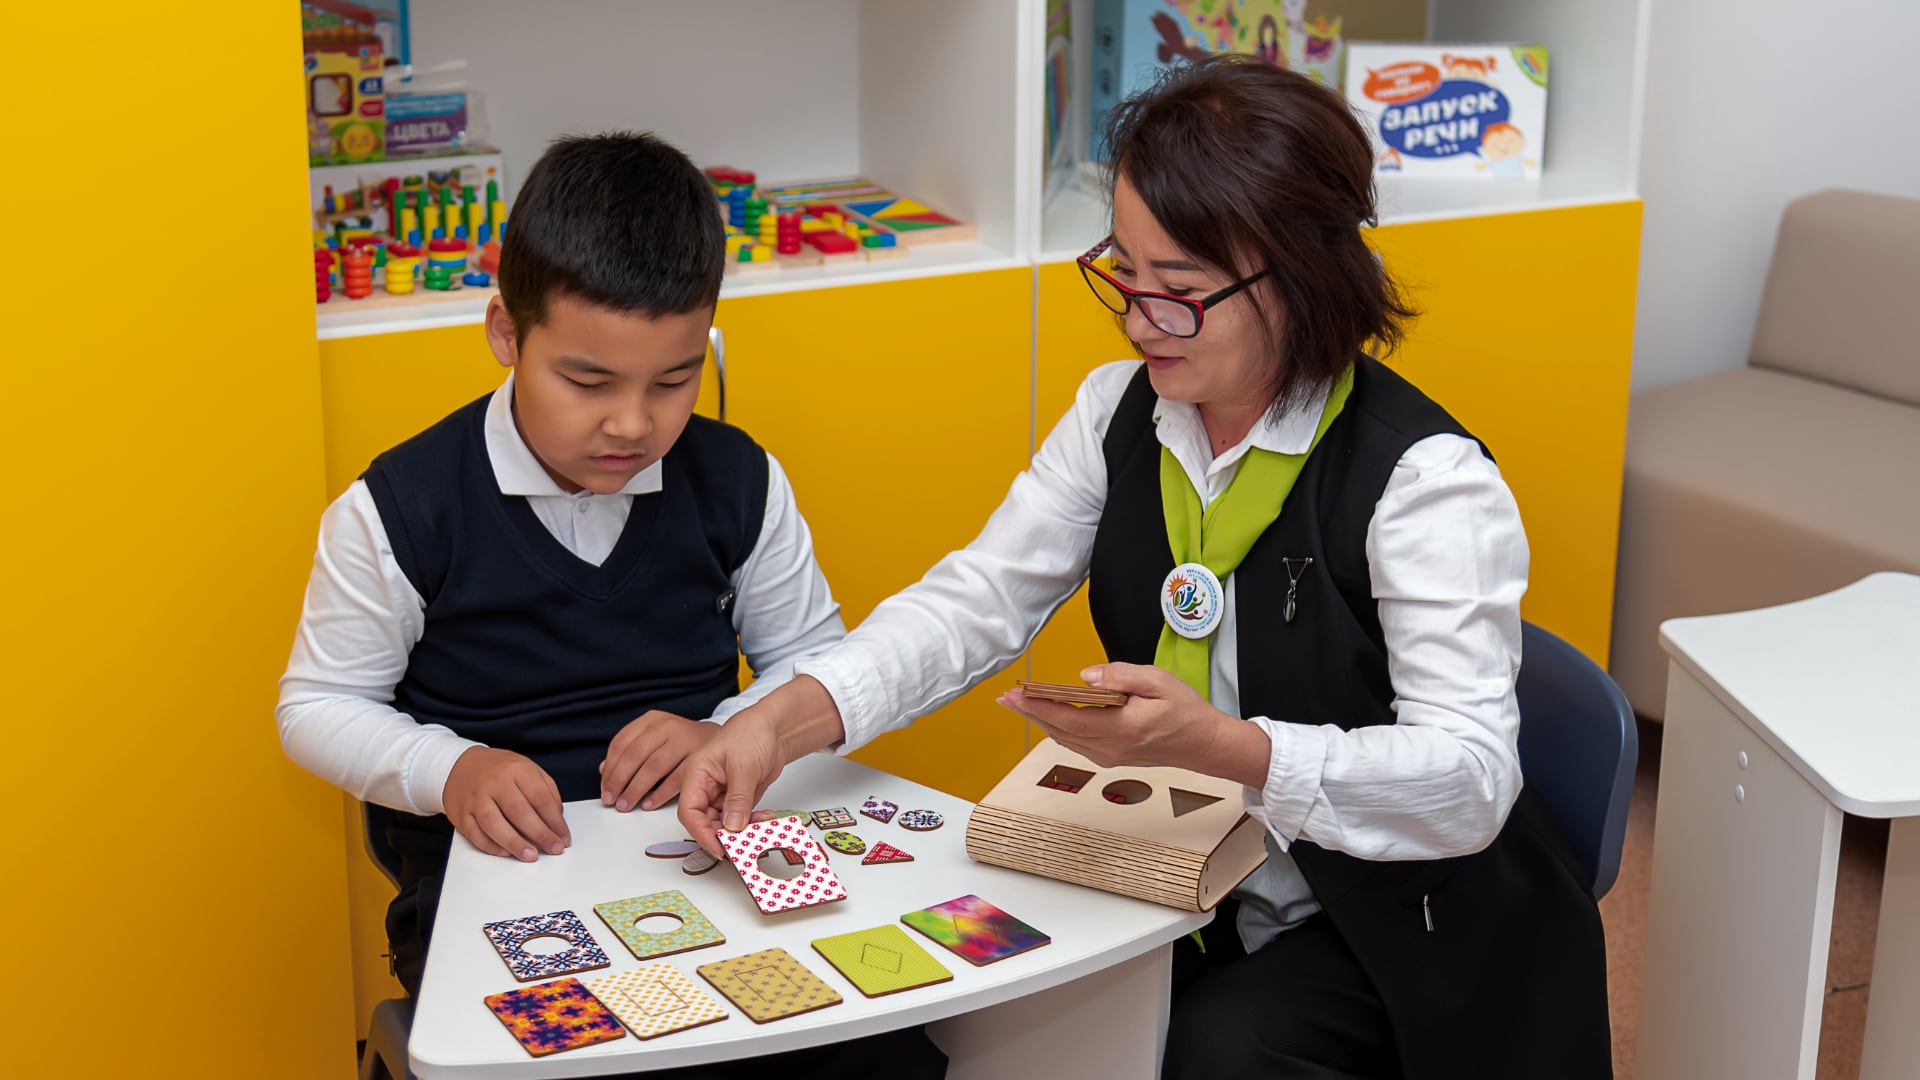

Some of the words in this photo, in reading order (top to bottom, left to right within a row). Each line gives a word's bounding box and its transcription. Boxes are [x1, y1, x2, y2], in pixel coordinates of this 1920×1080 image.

[1383, 91, 1498, 130] ЗАПУСК
[394, 122, 449, 142] ЦВЕТА
[1404, 117, 1479, 150] РЕЧИ
